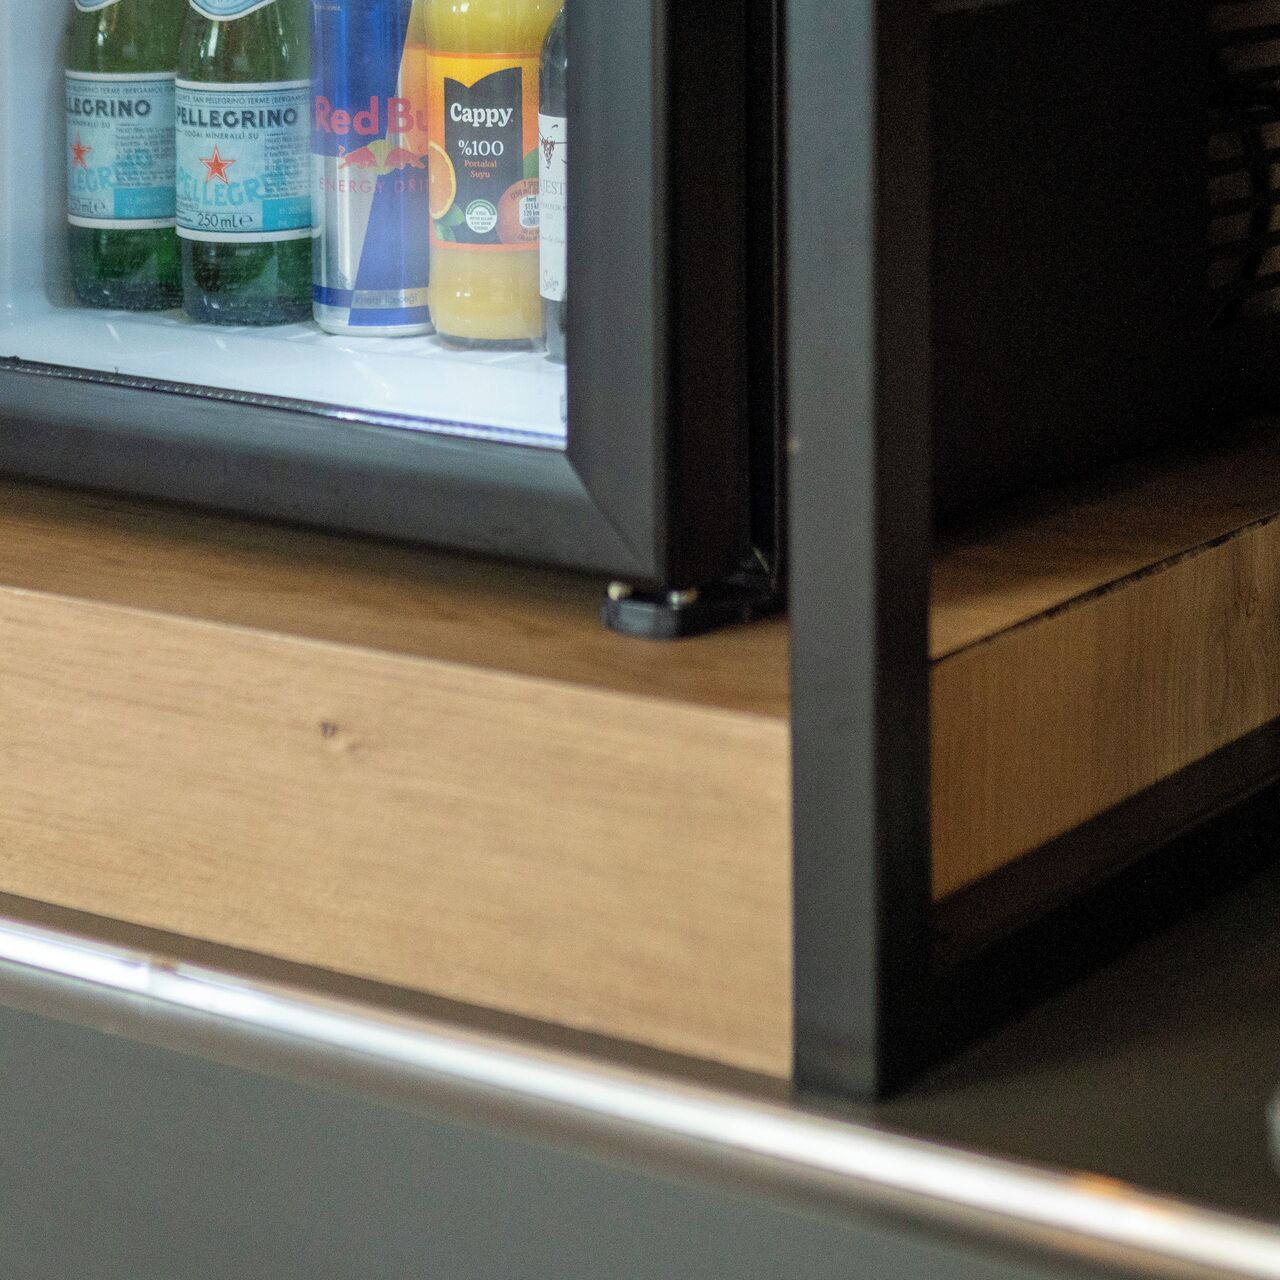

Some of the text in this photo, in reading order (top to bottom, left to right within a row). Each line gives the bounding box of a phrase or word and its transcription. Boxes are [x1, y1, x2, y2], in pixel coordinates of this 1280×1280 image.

[205, 97, 248, 106] PELLEGRINO
[176, 106, 297, 129] PELLEGRINO
[314, 94, 380, 135] Red
[450, 102, 513, 128] Cappy
[248, 132, 259, 140] SU
[458, 140, 505, 157] %100
[464, 159, 497, 168] Portakal
[470, 170, 490, 179] Suyu
[318, 177, 383, 194] ENERGY
[198, 213, 218, 228] 250
[220, 214, 238, 228] mL
